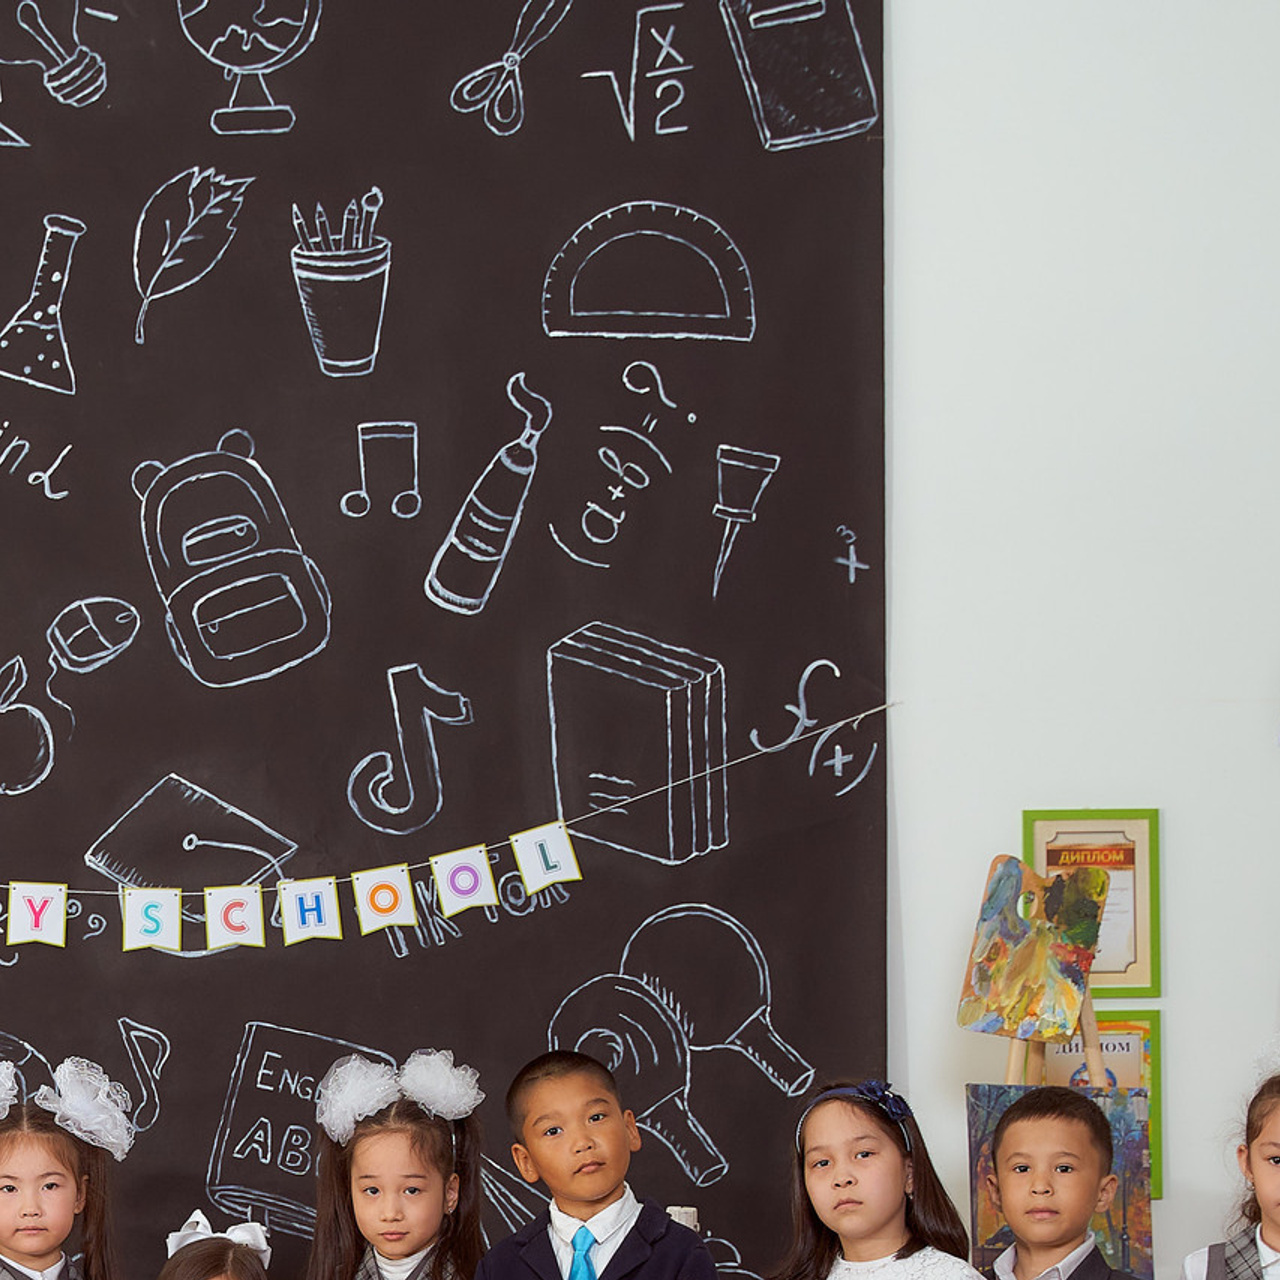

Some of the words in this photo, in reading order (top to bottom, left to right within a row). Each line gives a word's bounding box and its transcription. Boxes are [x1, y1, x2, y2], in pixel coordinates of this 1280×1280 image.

[1058, 850, 1125, 866] ДИПЛОМ
[139, 839, 562, 938] SCHOOL
[1055, 1041, 1132, 1055] ДИОМ
